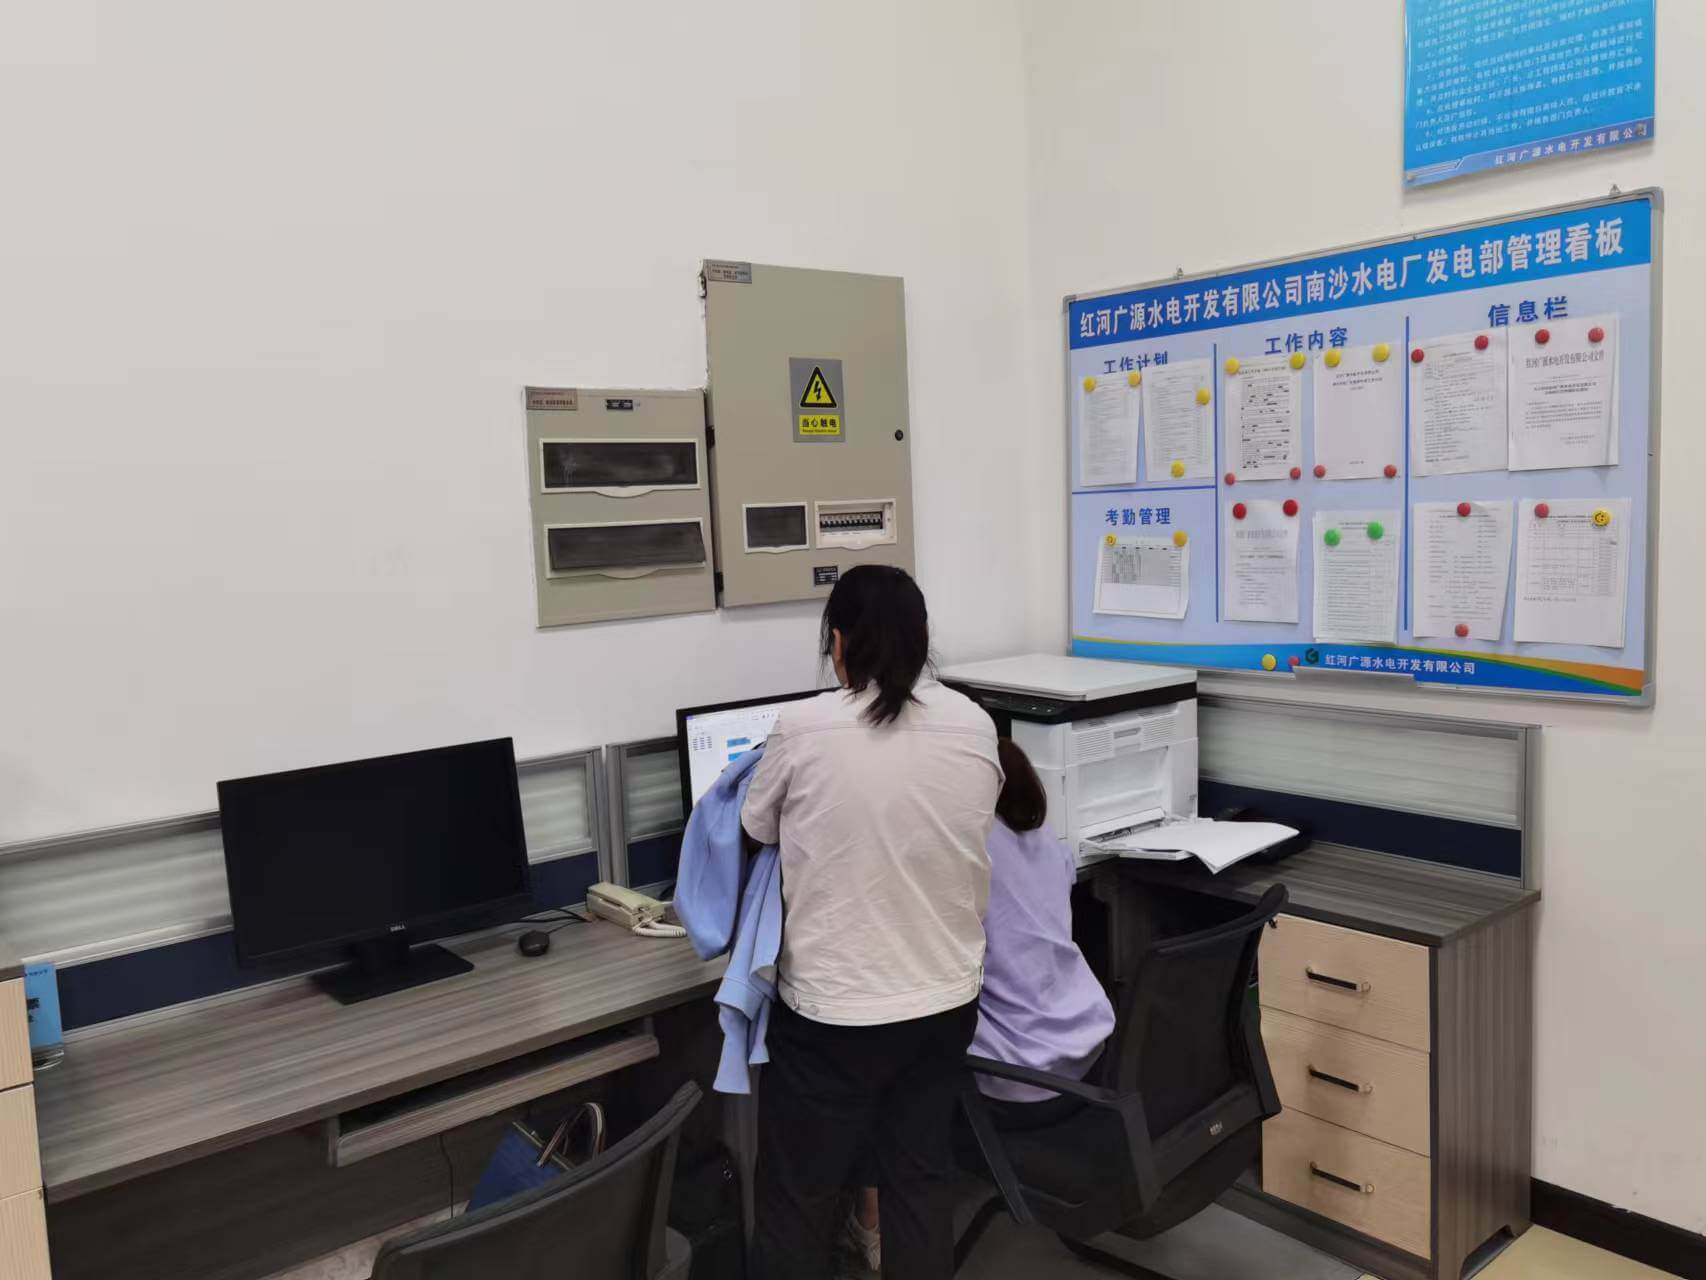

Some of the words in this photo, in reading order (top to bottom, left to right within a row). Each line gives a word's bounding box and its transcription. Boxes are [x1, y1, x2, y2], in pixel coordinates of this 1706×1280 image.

[1079, 217, 1624, 338] 红河广源水电开发有限公司南沙水电厂发电部管理看板
[1487, 295, 1568, 327] 信息栏
[1264, 326, 1348, 355] 工作内容
[1103, 351, 1168, 375] 工作计划
[1105, 507, 1171, 526] 考勤管理
[1324, 654, 1476, 675] 红河广源水电开发有限公司
